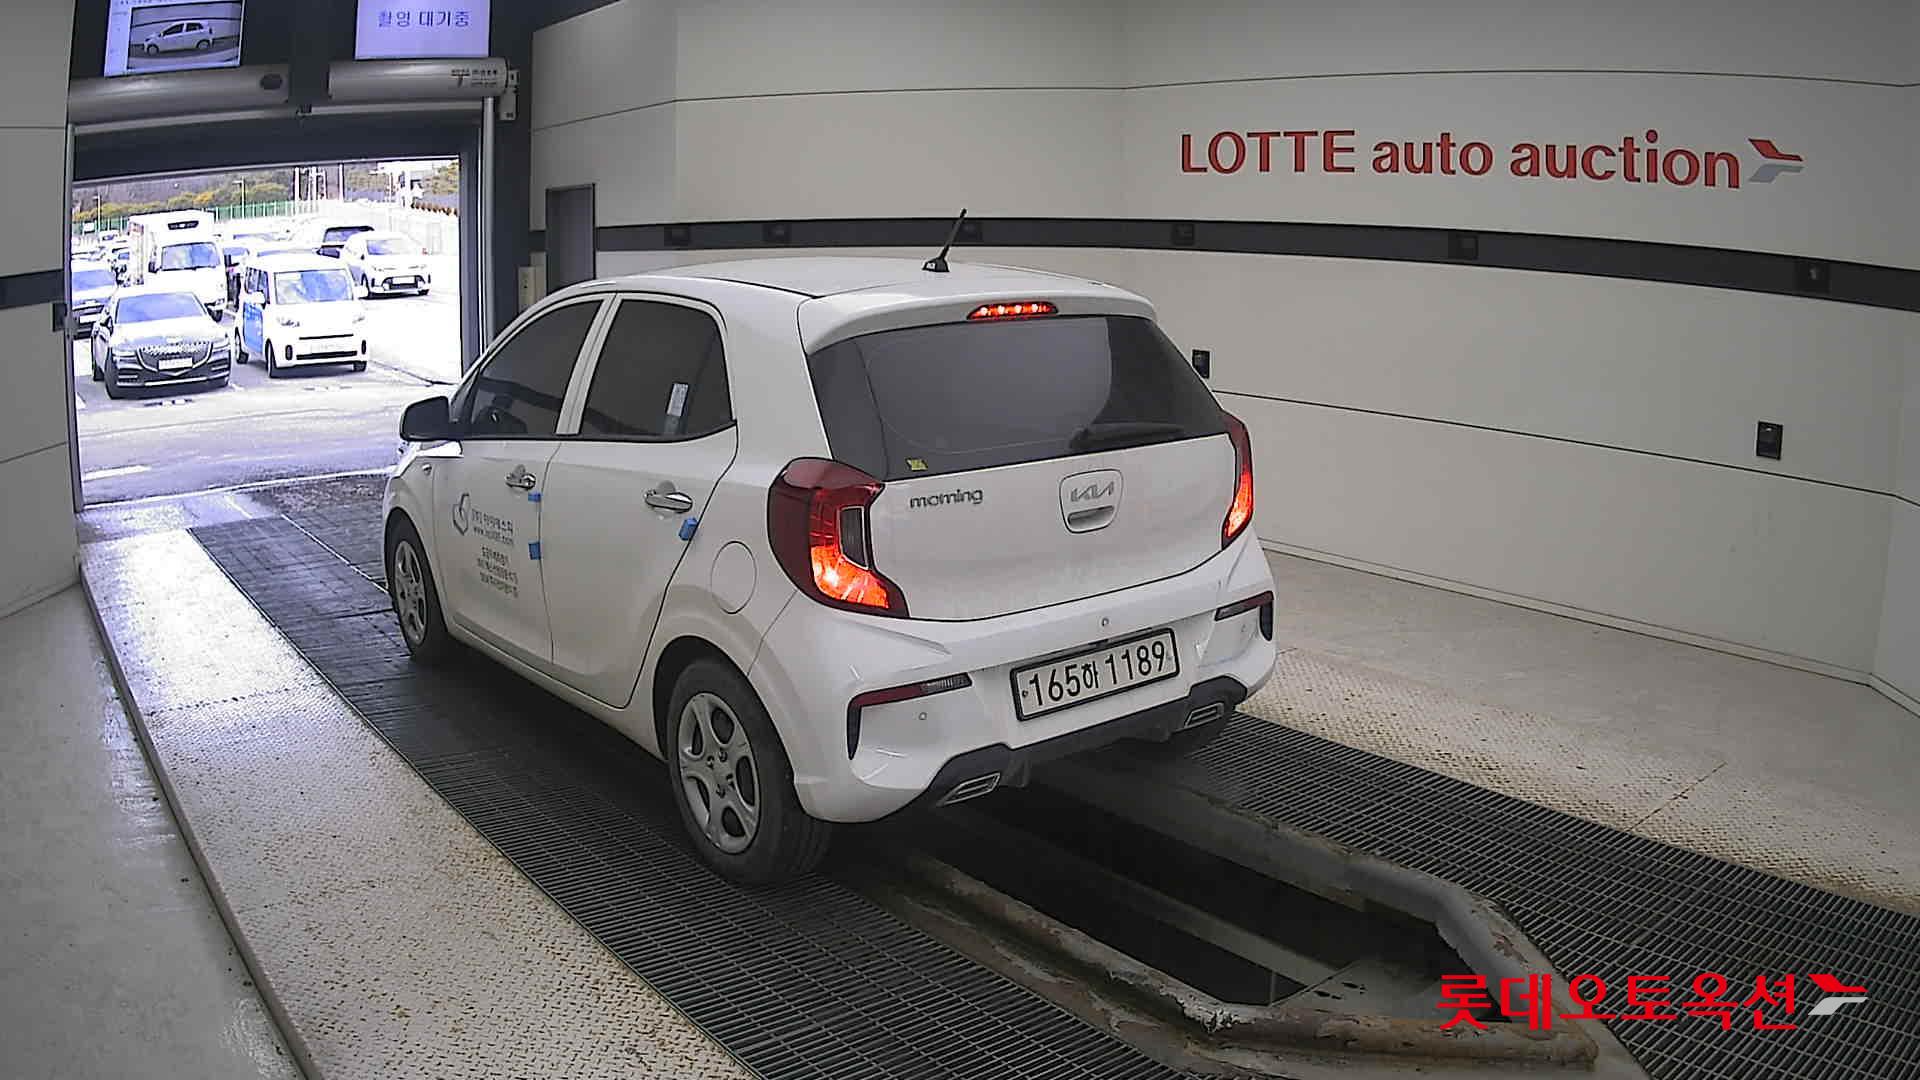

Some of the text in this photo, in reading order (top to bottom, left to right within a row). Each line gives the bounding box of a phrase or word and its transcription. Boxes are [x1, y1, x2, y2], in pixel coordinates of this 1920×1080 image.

[419, 10, 471, 28] 대기중
[1180, 130, 1742, 190] LOTTE auto auction
[909, 488, 985, 509] morning
[1029, 640, 1165, 707] 165하 1189
